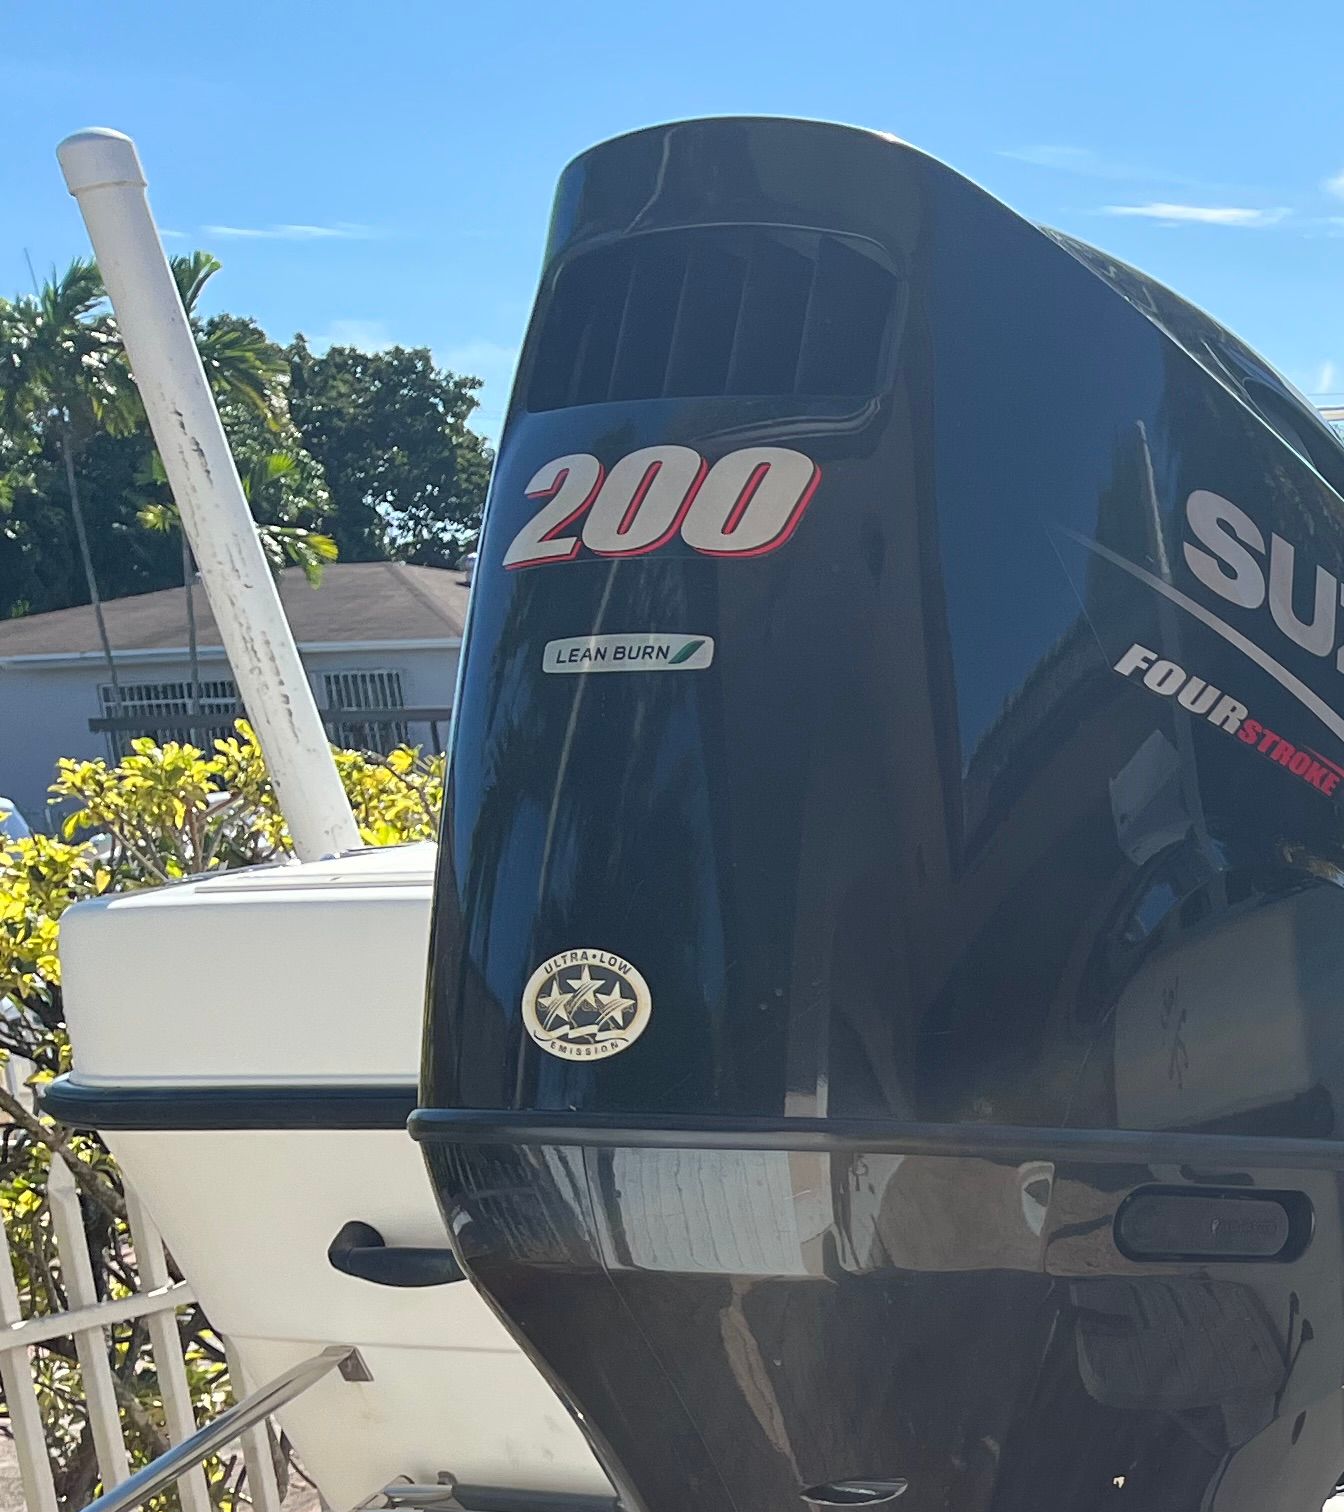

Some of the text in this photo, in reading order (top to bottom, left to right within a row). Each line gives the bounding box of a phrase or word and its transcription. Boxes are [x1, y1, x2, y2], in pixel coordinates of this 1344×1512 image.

[502, 445, 822, 570] 200
[555, 644, 671, 665] LEAN BURN
[550, 1041, 619, 1056] EMISSION
